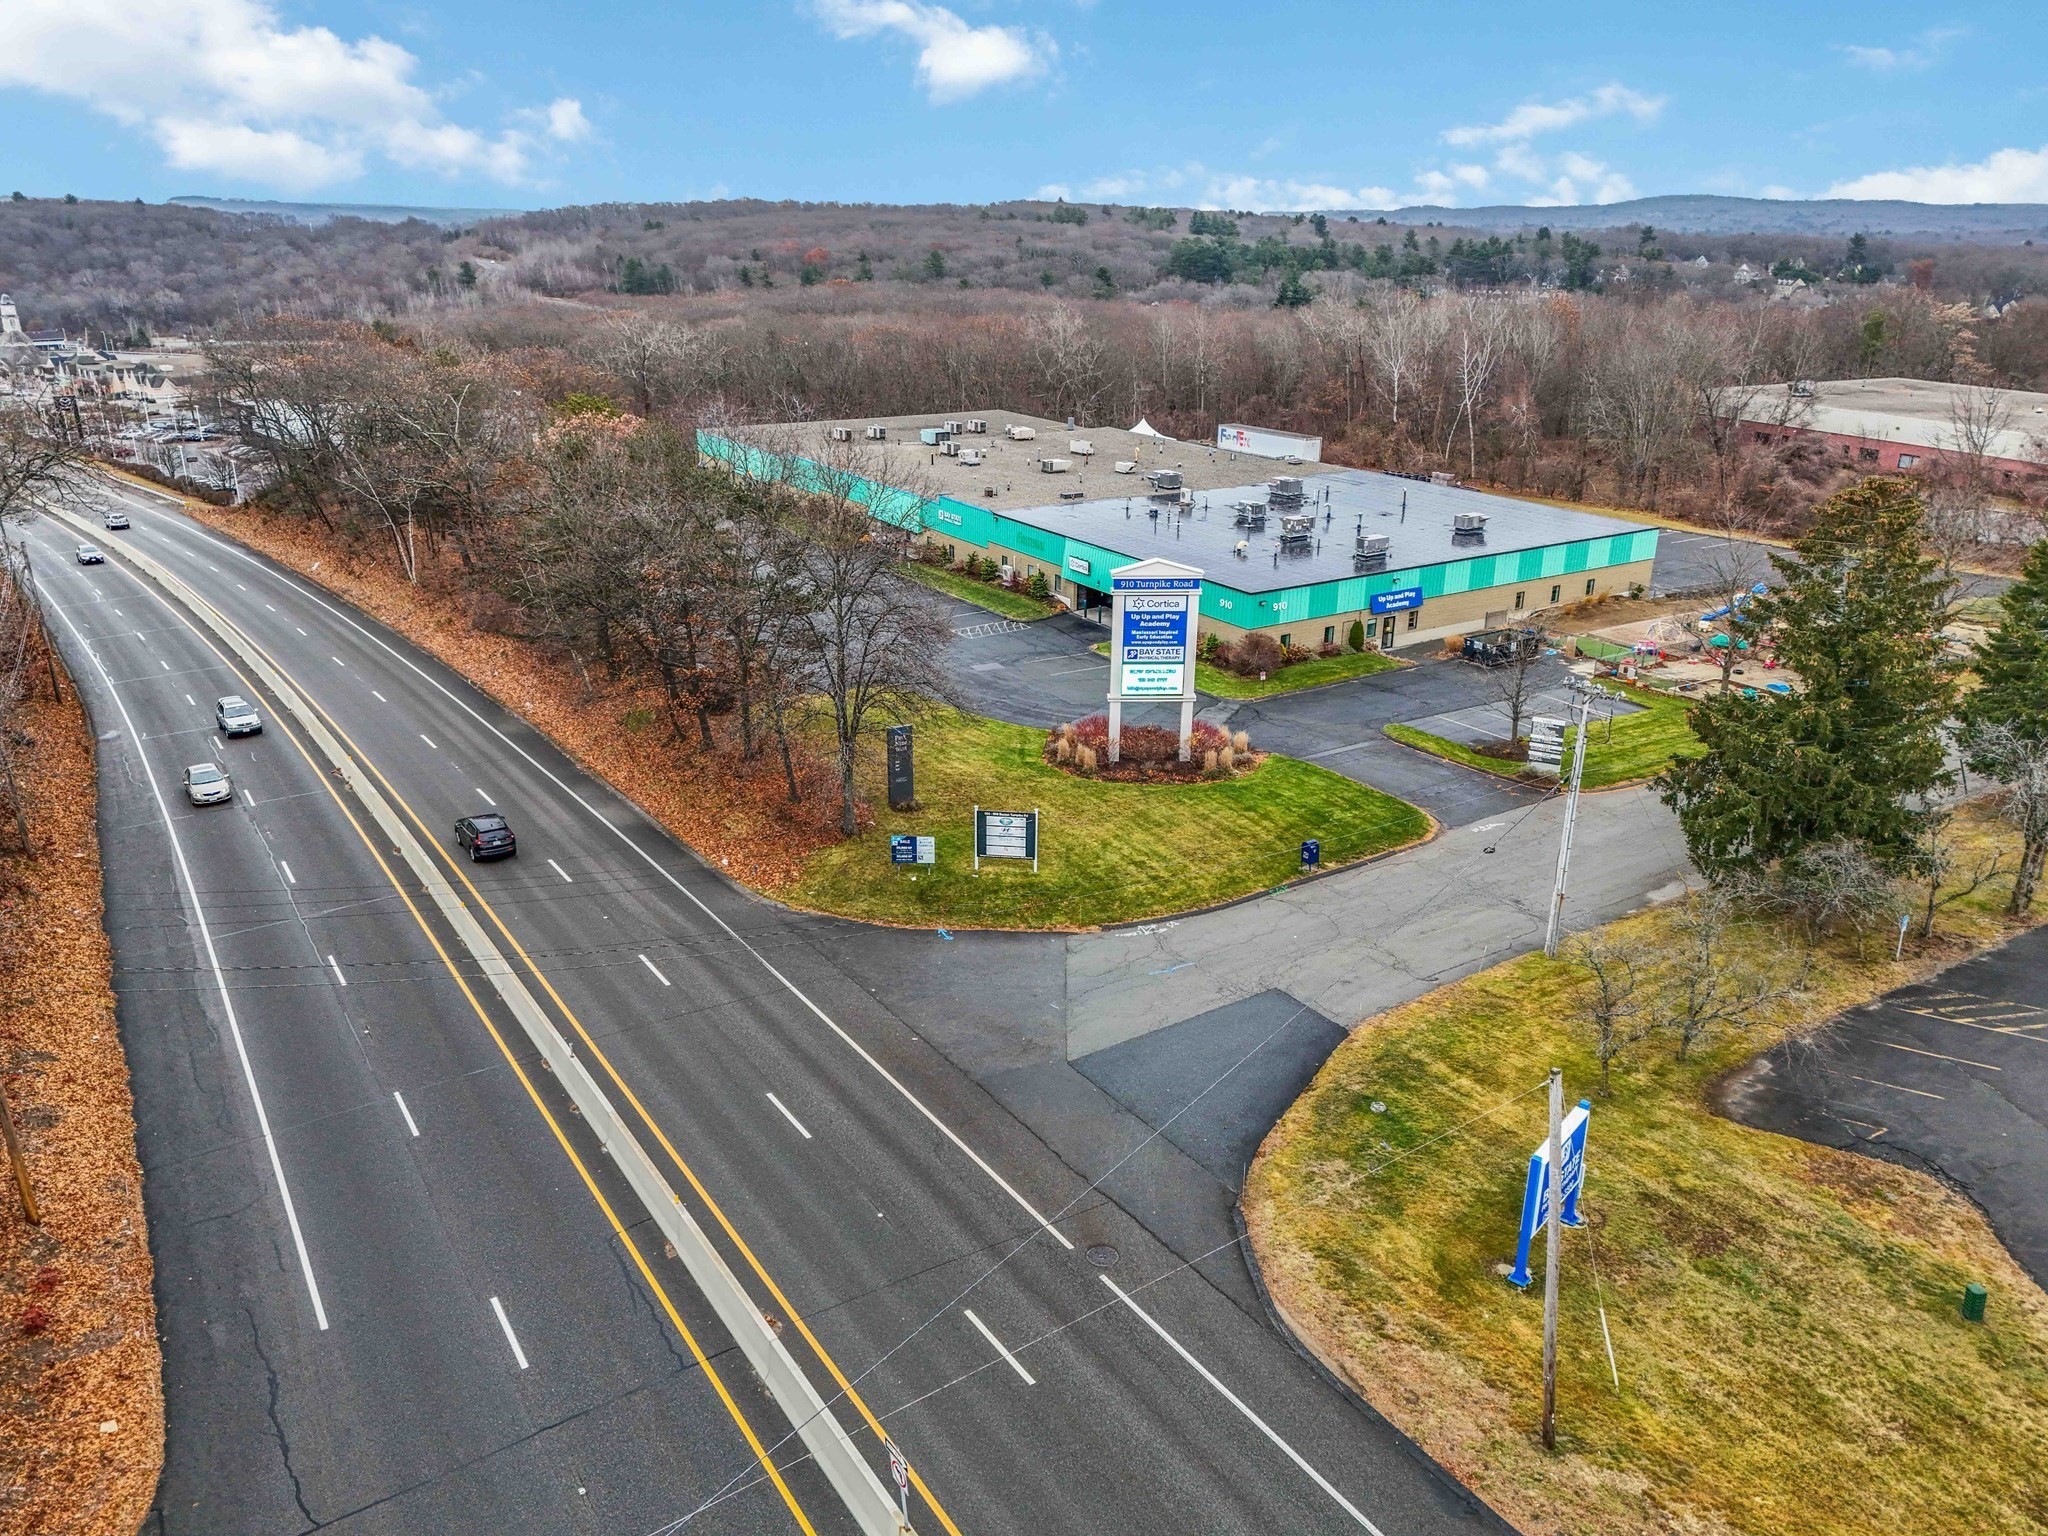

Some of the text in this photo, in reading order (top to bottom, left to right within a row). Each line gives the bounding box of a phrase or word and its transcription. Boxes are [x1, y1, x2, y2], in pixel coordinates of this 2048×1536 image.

[1120, 580, 1134, 588] 910
[1136, 580, 1171, 589] Turnpike
[1147, 600, 1180, 608] Cortica
[1219, 598, 1233, 610] 910
[1272, 601, 1288, 612] 910
[1386, 600, 1410, 609] Academy
[1165, 613, 1180, 621] Play
